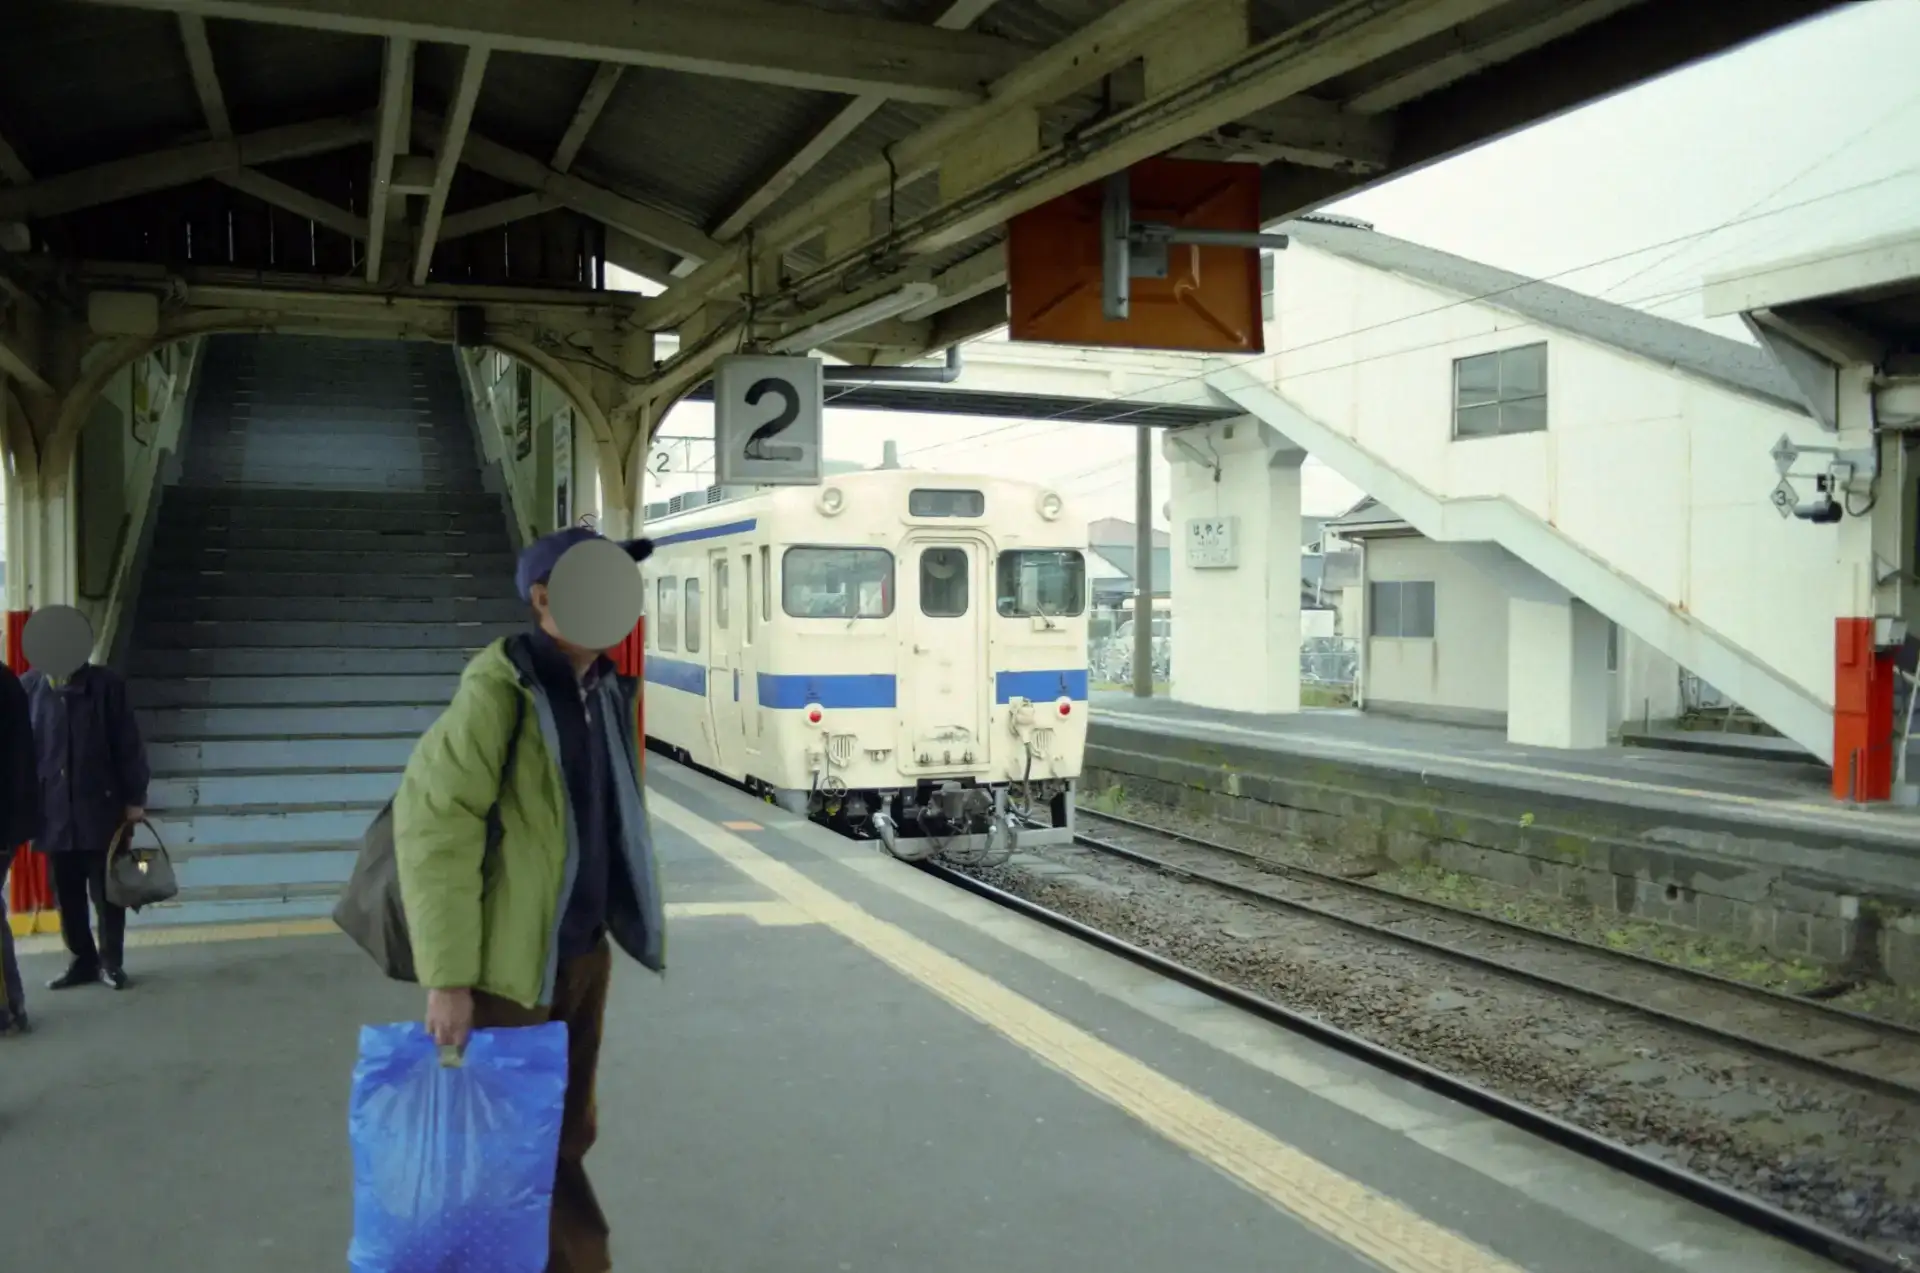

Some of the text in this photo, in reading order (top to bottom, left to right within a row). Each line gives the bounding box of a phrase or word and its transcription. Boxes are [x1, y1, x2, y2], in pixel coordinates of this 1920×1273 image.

[744, 377, 803, 461] 2
[656, 452, 671, 473] 2
[1775, 490, 1787, 506] 3
